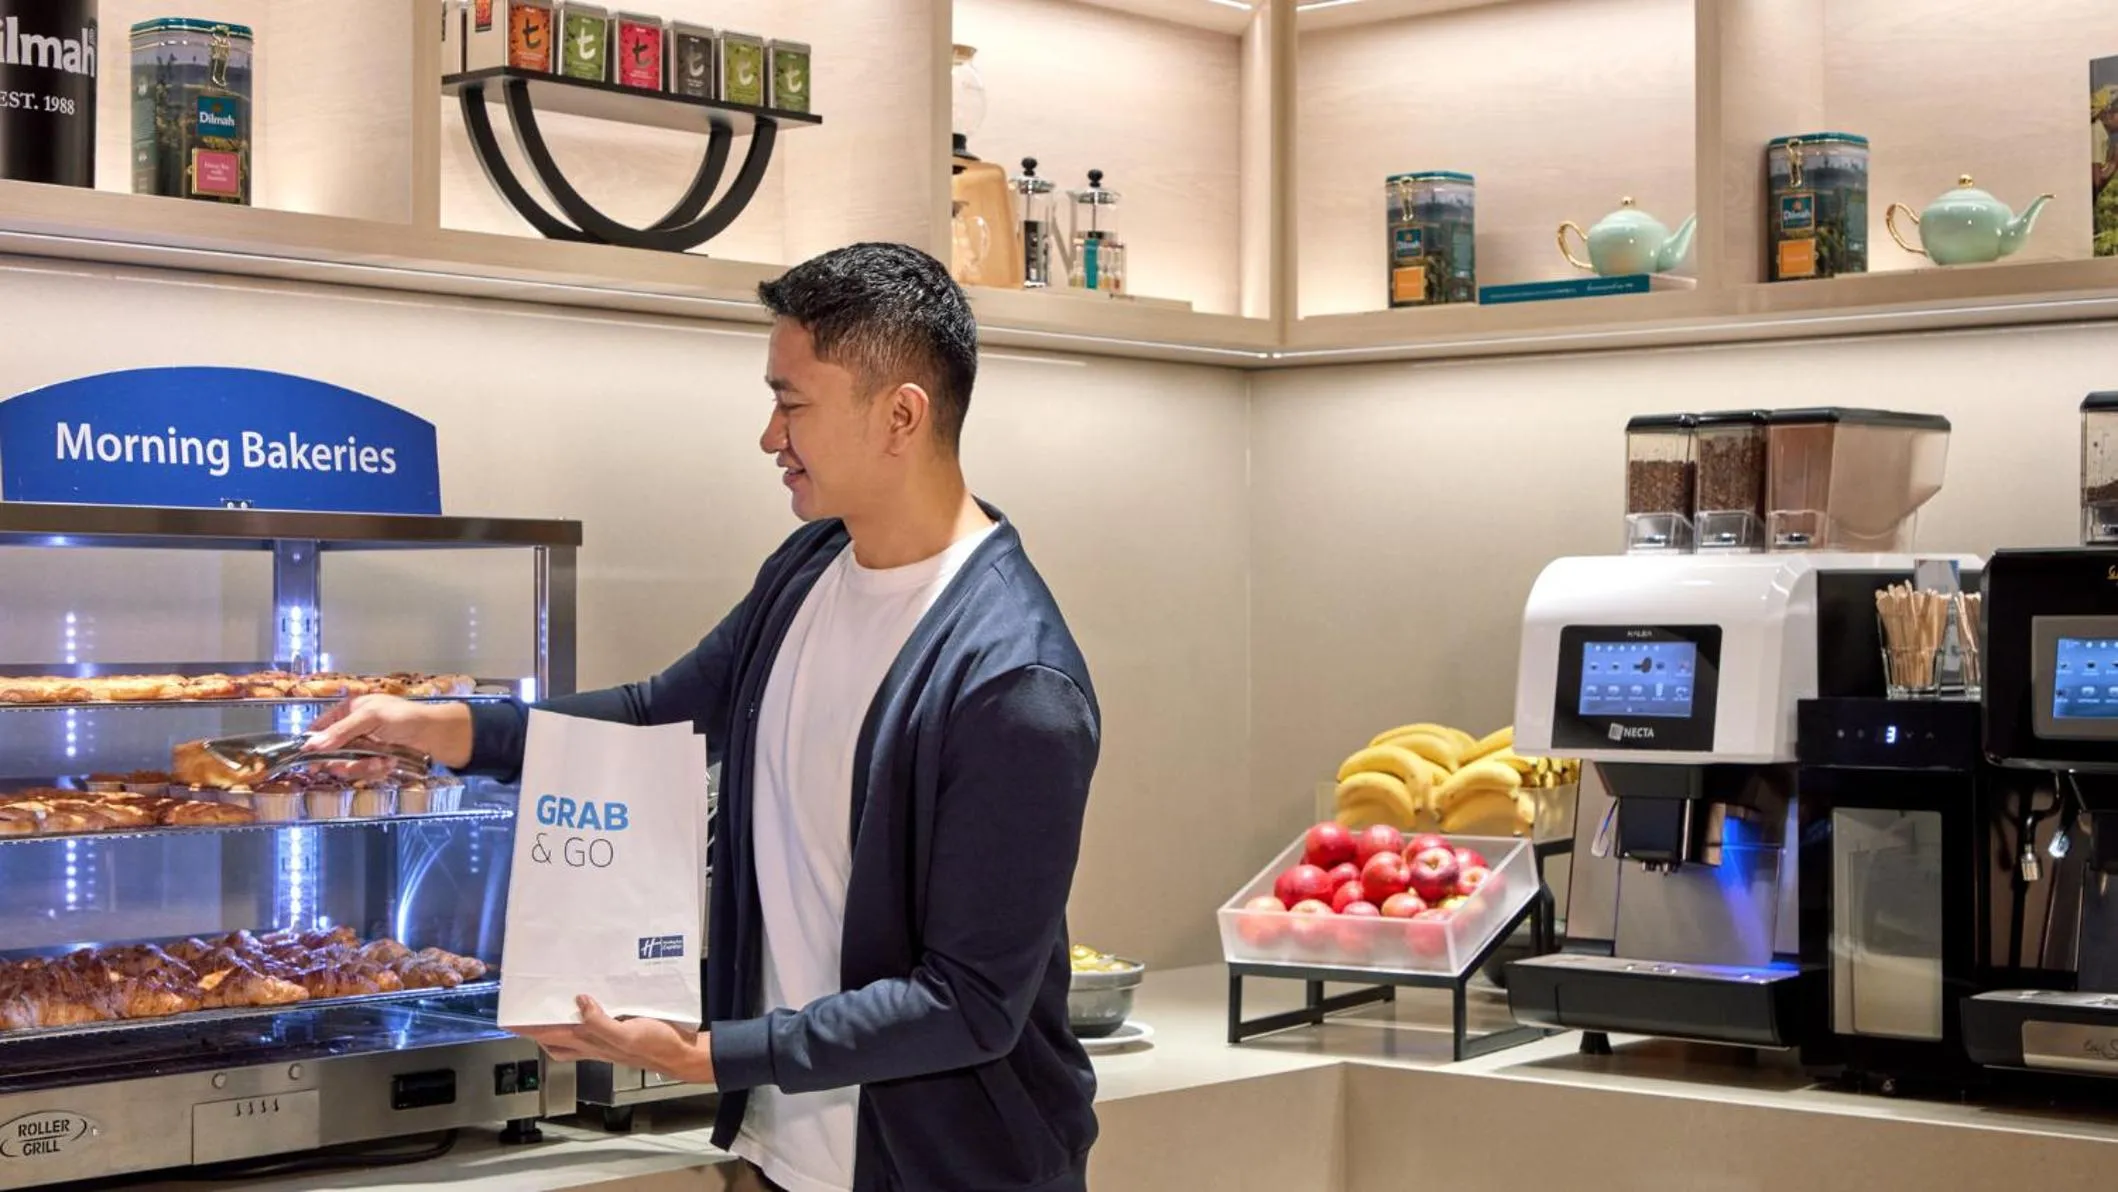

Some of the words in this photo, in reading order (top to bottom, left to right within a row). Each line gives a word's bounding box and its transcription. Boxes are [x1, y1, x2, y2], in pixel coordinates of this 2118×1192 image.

[44, 95, 76, 115] 1988
[199, 111, 236, 127] Dilmah
[56, 421, 230, 477] Morning
[241, 430, 397, 474] Bakeries
[1623, 727, 1655, 739] NECTA
[1886, 725, 1897, 744] 3
[536, 794, 630, 831] GRAB
[531, 832, 552, 865] &
[564, 836, 614, 868] GO
[18, 1119, 70, 1137] ROLLER
[23, 1140, 61, 1156] GRILL
